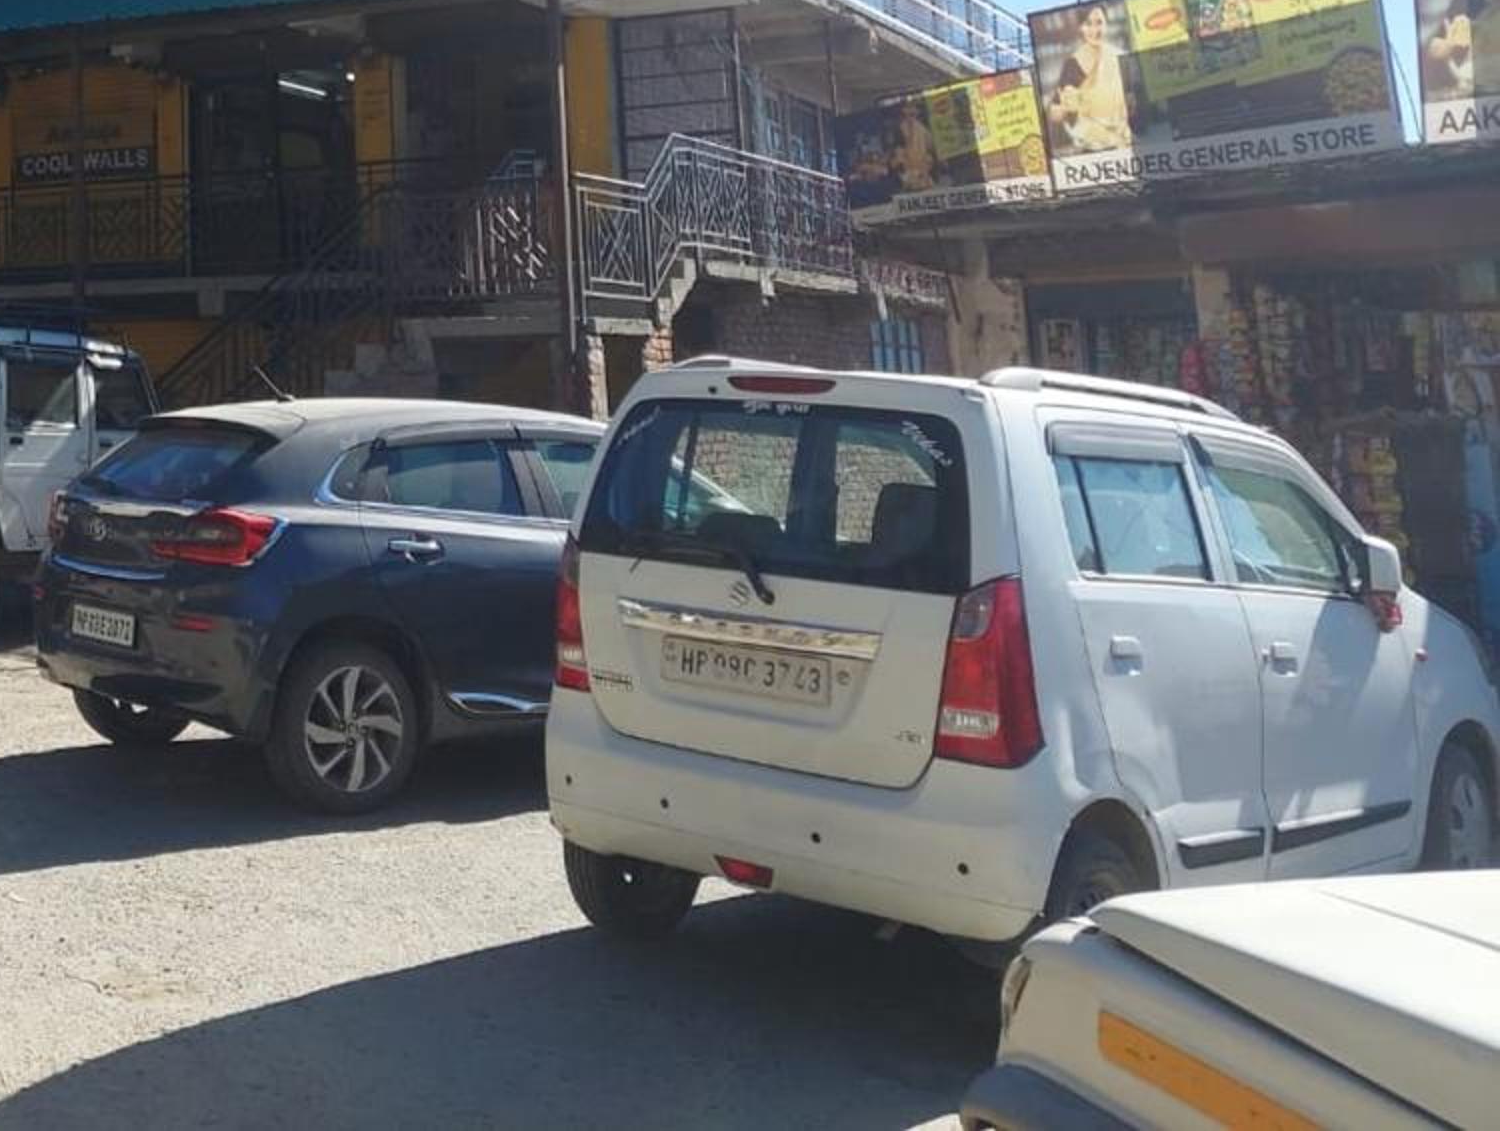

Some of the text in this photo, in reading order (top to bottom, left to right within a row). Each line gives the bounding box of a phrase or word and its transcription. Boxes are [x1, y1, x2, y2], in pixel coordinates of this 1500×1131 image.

[22, 148, 149, 177] COOL WALLS
[1065, 124, 1376, 184] RAJENDER GENERAL STORE
[680, 647, 708, 677] HP
